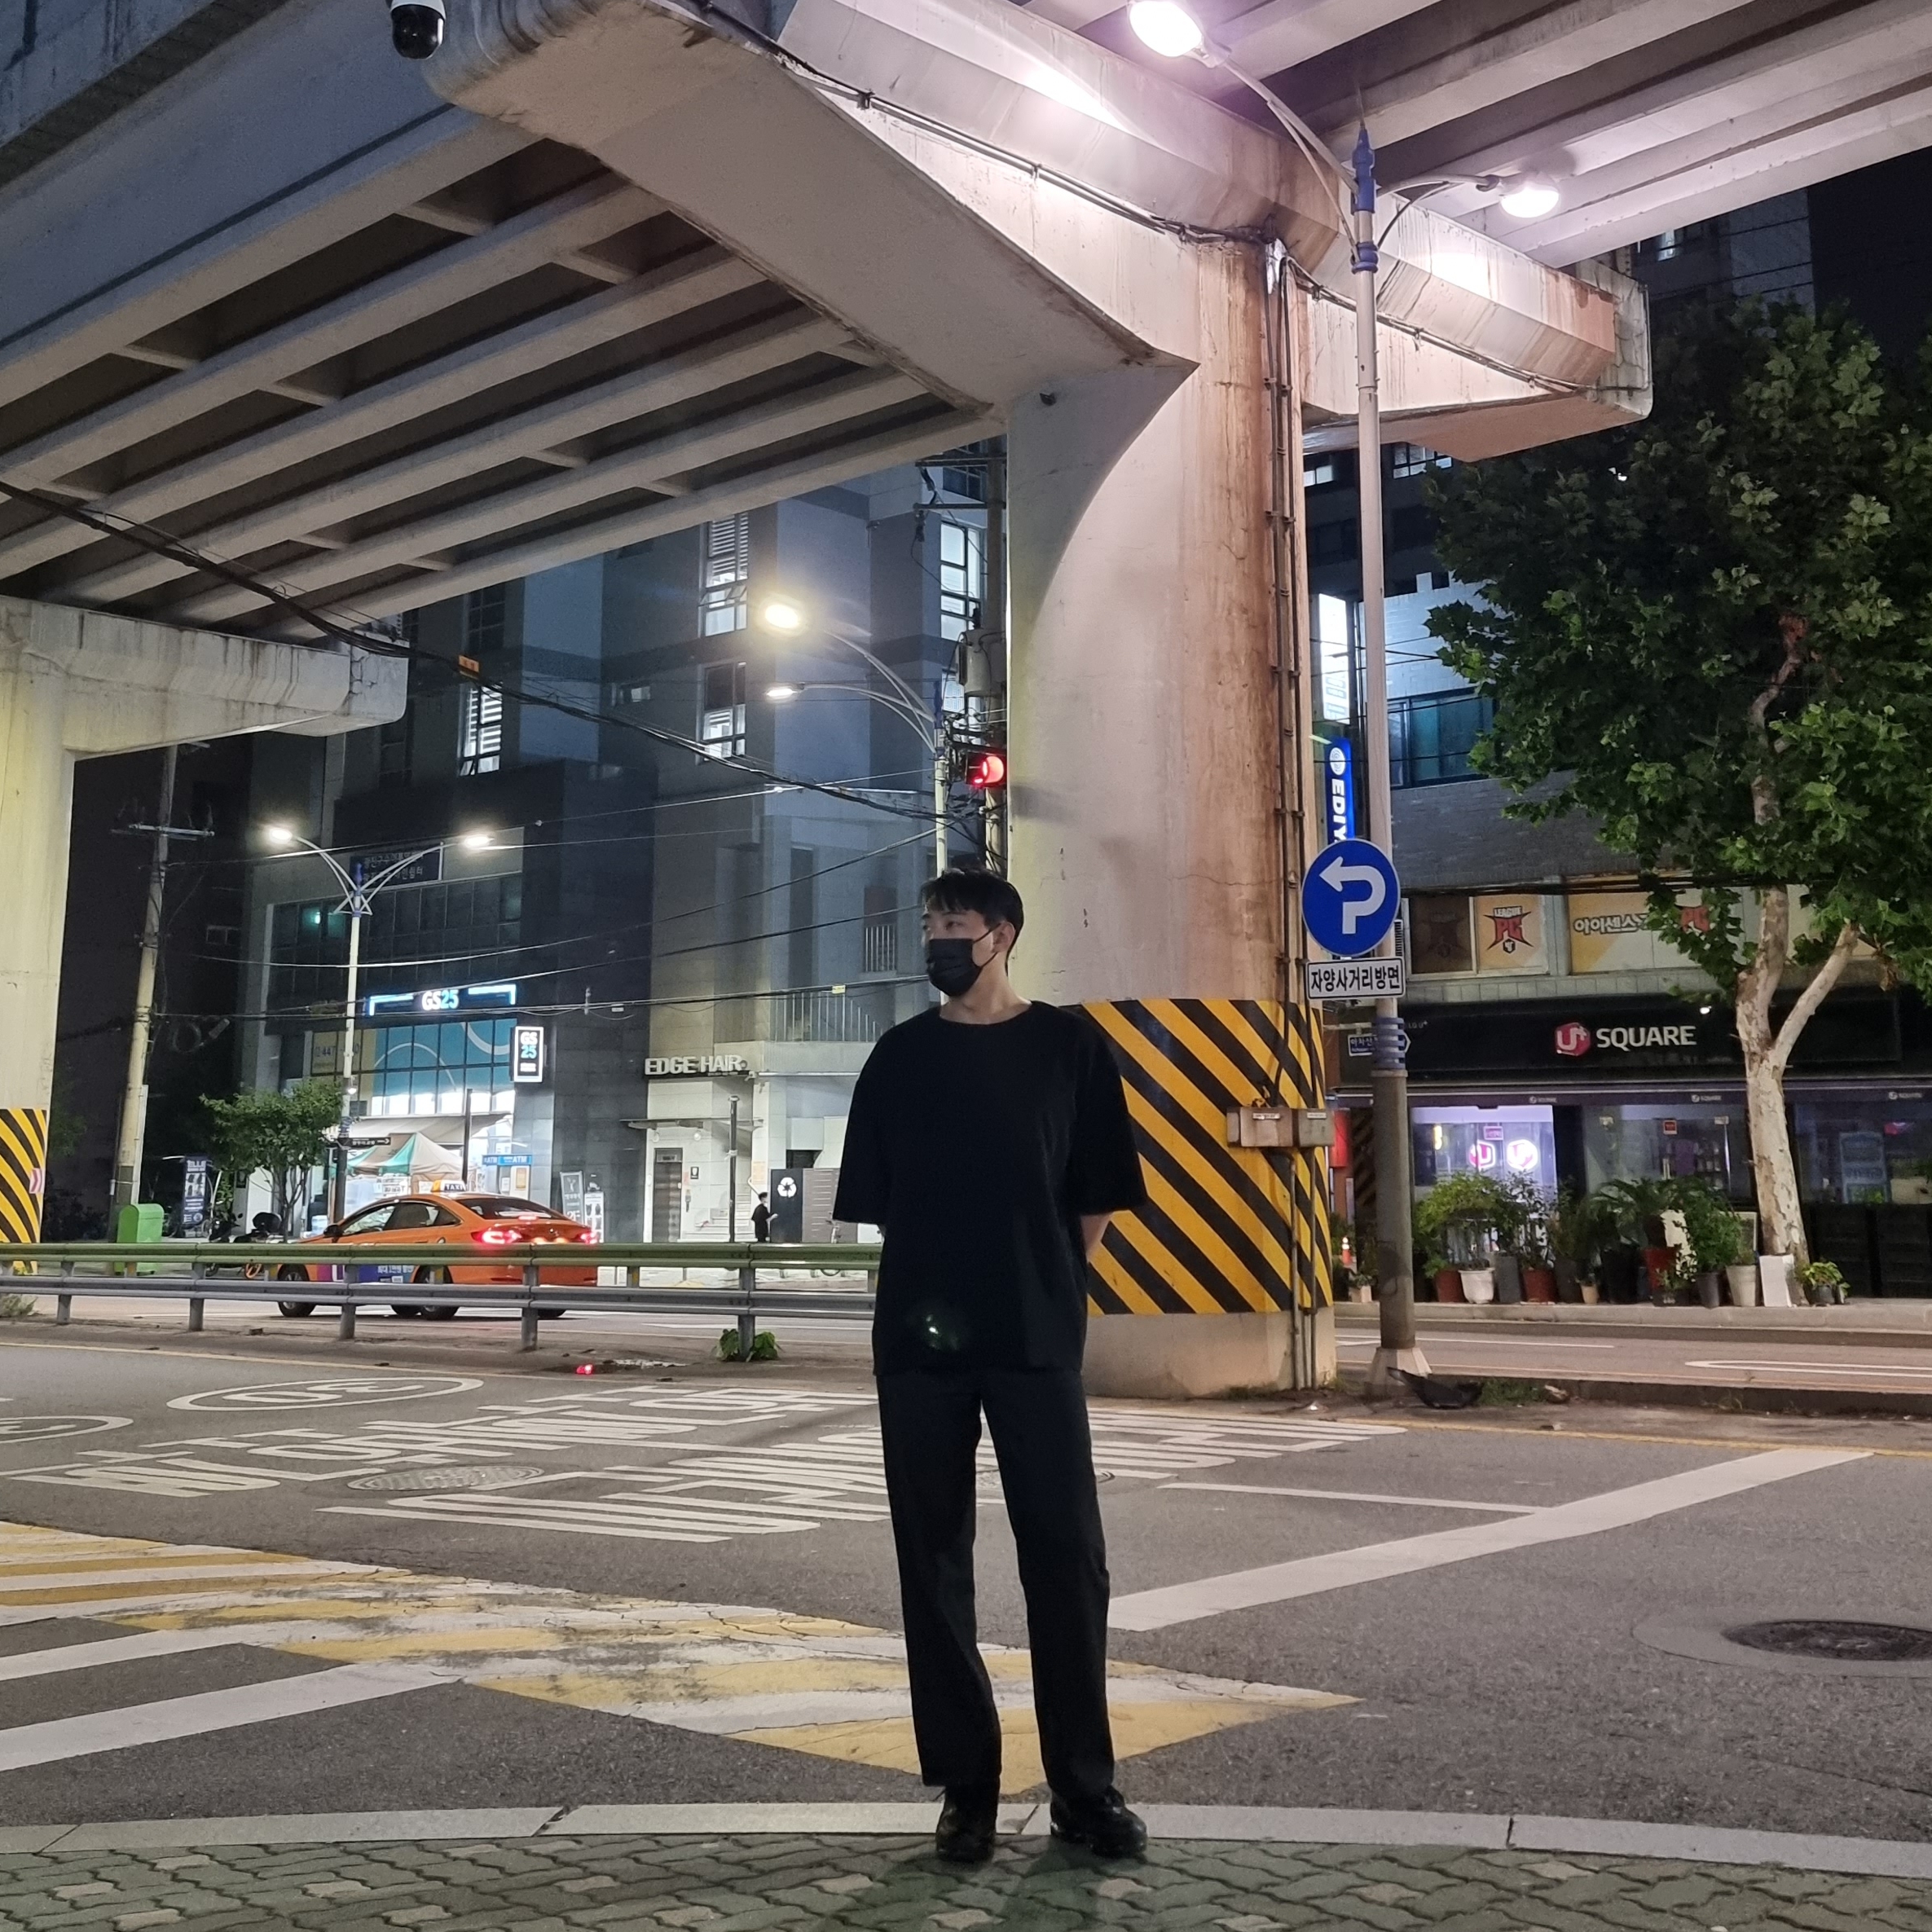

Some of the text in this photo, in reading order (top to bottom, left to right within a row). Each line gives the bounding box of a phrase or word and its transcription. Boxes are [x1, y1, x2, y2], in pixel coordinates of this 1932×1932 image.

[1331, 778, 1347, 843] EDIY
[1494, 906, 1522, 918] LEAGUE
[1573, 913, 1648, 935] 아이센스
[1310, 965, 1401, 992] 자양사거리방면
[421, 989, 460, 1010] GS25
[520, 1031, 538, 1045] GS
[1350, 1036, 1378, 1047] 아차산
[1595, 1025, 1697, 1052] SQUARE
[521, 1045, 537, 1058] 25
[645, 1054, 742, 1076] EDGE HAIR
[512, 1155, 526, 1163] ATM
[444, 1183, 464, 1191] TAXI
[222, 1382, 425, 1403] 30
